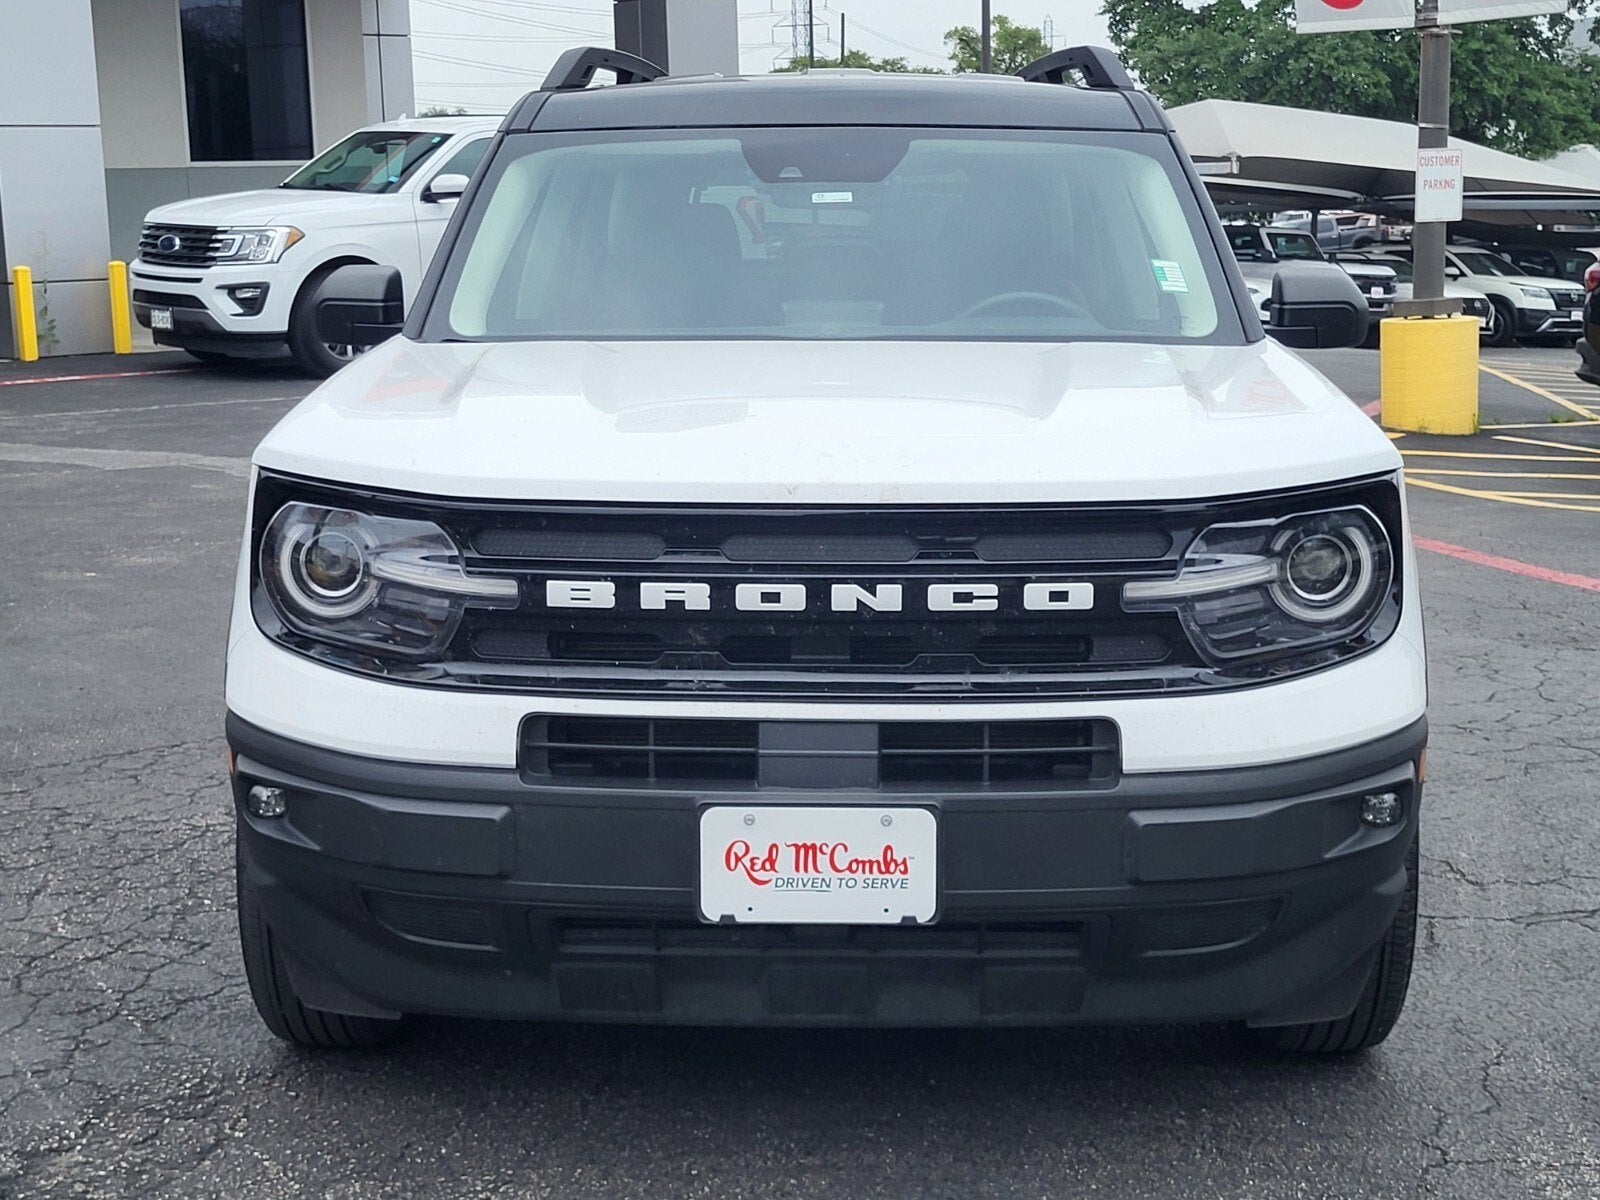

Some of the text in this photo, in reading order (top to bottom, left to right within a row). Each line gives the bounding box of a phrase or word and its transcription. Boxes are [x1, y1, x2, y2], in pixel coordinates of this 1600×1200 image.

[1419, 155, 1460, 167] CUSTOMER
[1423, 179, 1455, 190] PARKING
[546, 580, 1094, 611] BRONCO
[724, 840, 909, 885] Red McCombs
[774, 877, 909, 889] DRIVEN TO SERVE
